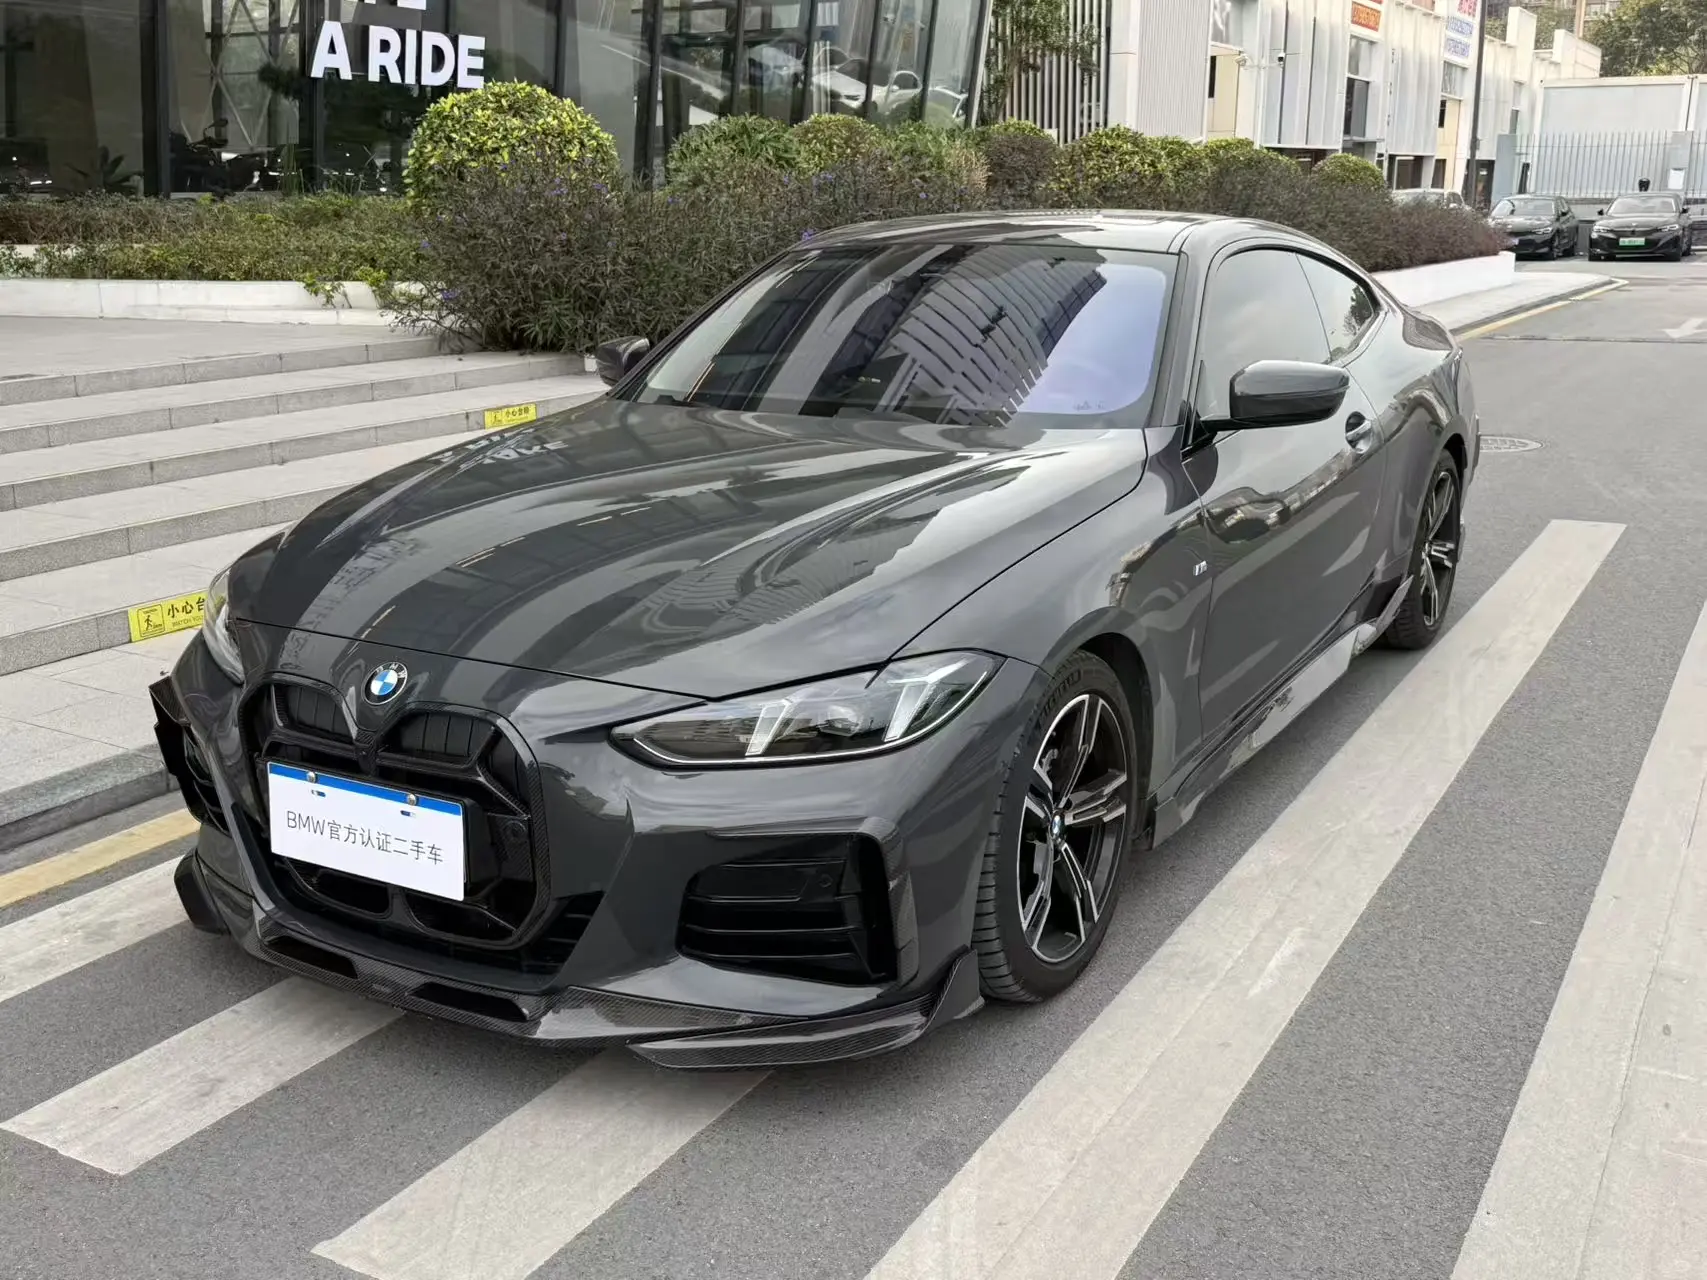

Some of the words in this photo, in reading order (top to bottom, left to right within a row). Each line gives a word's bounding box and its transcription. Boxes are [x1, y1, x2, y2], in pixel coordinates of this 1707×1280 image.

[310, 20, 352, 80] A
[368, 25, 486, 89] RIDE
[286, 810, 444, 866] BMW官方认证二手车
